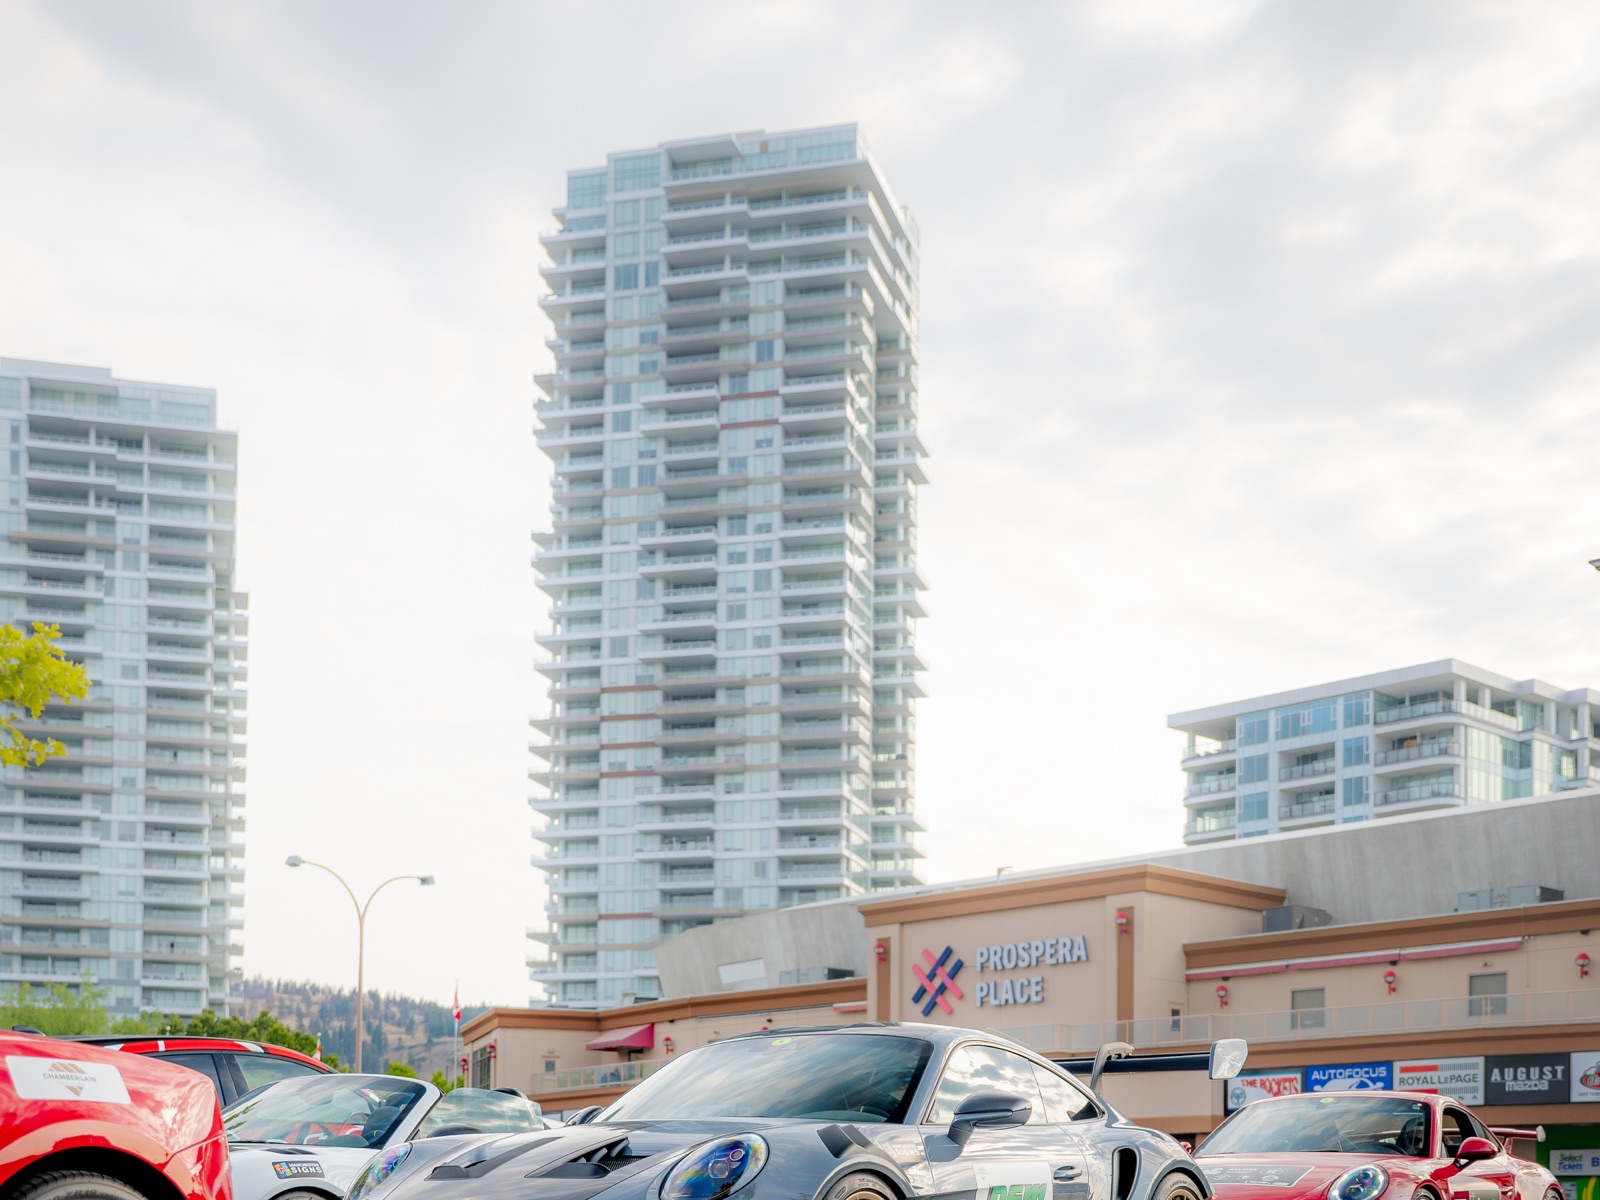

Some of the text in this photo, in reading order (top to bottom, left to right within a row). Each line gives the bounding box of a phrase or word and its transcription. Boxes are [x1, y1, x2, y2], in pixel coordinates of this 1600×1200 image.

[976, 935, 1088, 972] PROSPERA
[976, 976, 1045, 1007] PLACE
[43, 1072, 97, 1083] CHAMBERLAIN
[1311, 1067, 1387, 1080] AUTOFOCUS
[1490, 1065, 1565, 1082] AUGUST
[1241, 1076, 1299, 1098] THE ROCKETS
[1400, 1077, 1437, 1086] ROYAL
[1505, 1079, 1549, 1092] mazda
[1559, 1153, 1583, 1162] Select
[290, 1166, 322, 1174] SIGNS
[1557, 1162, 1583, 1170] Tickets
